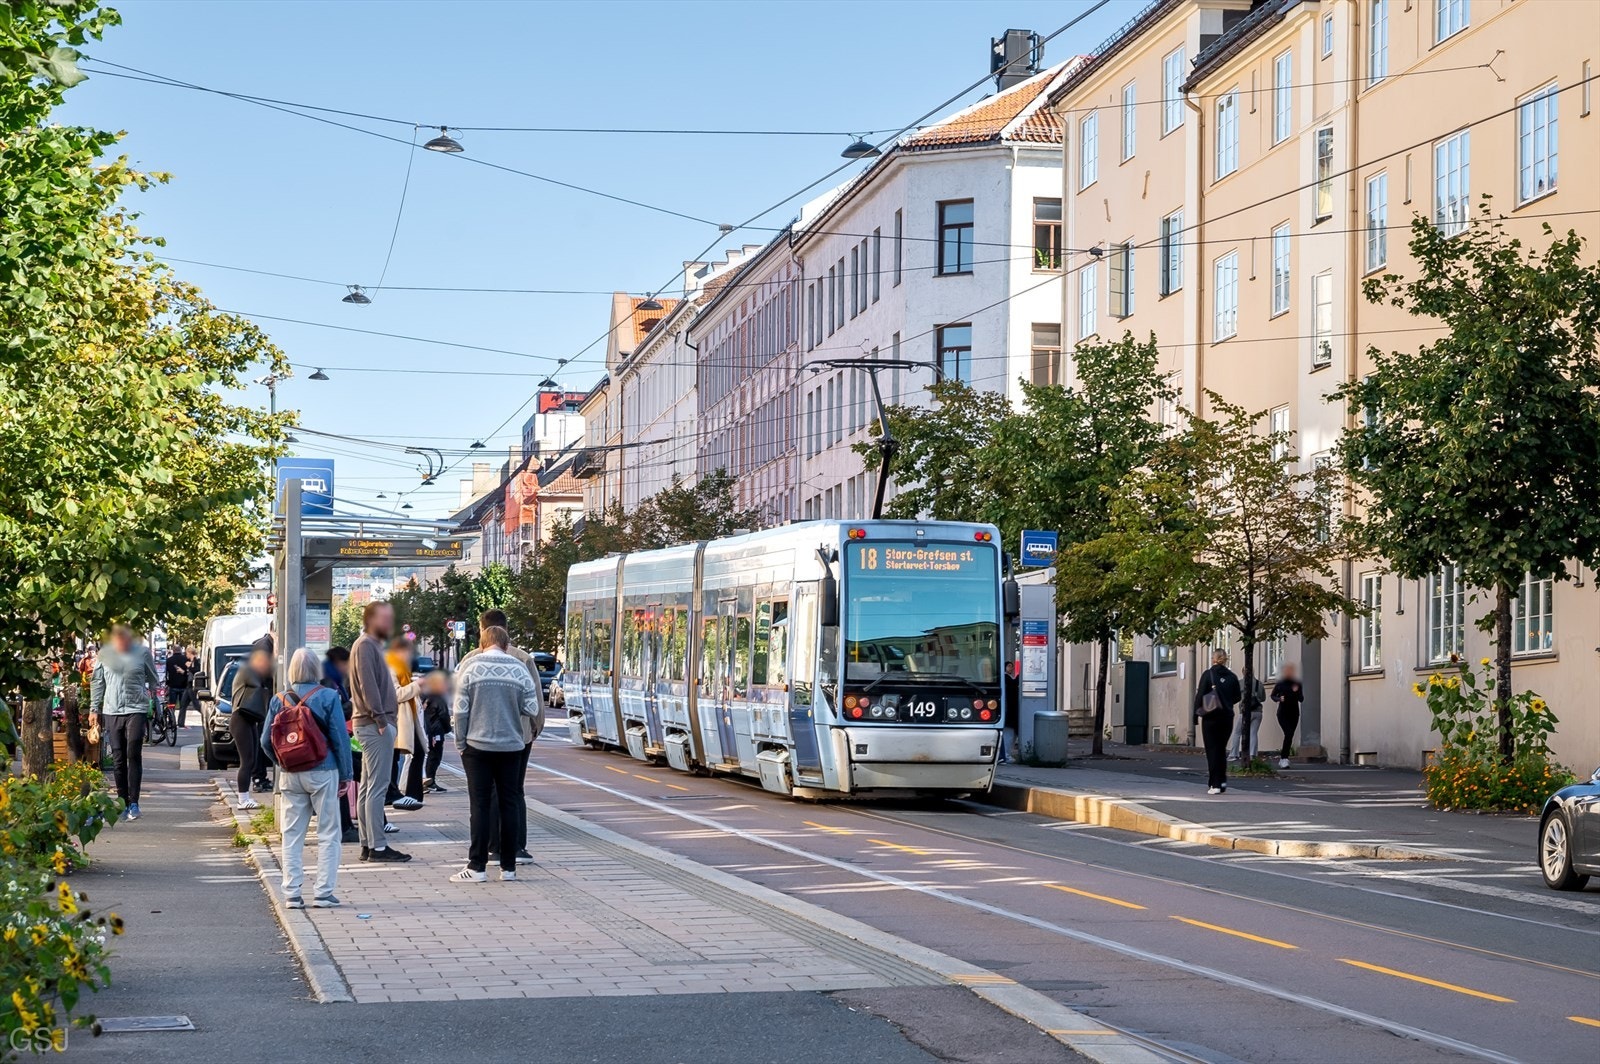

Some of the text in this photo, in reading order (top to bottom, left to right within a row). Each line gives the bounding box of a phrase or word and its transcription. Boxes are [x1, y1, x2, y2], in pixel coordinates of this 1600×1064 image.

[860, 548, 877, 570] 18
[959, 550, 974, 562] st.
[907, 701, 936, 718] 149
